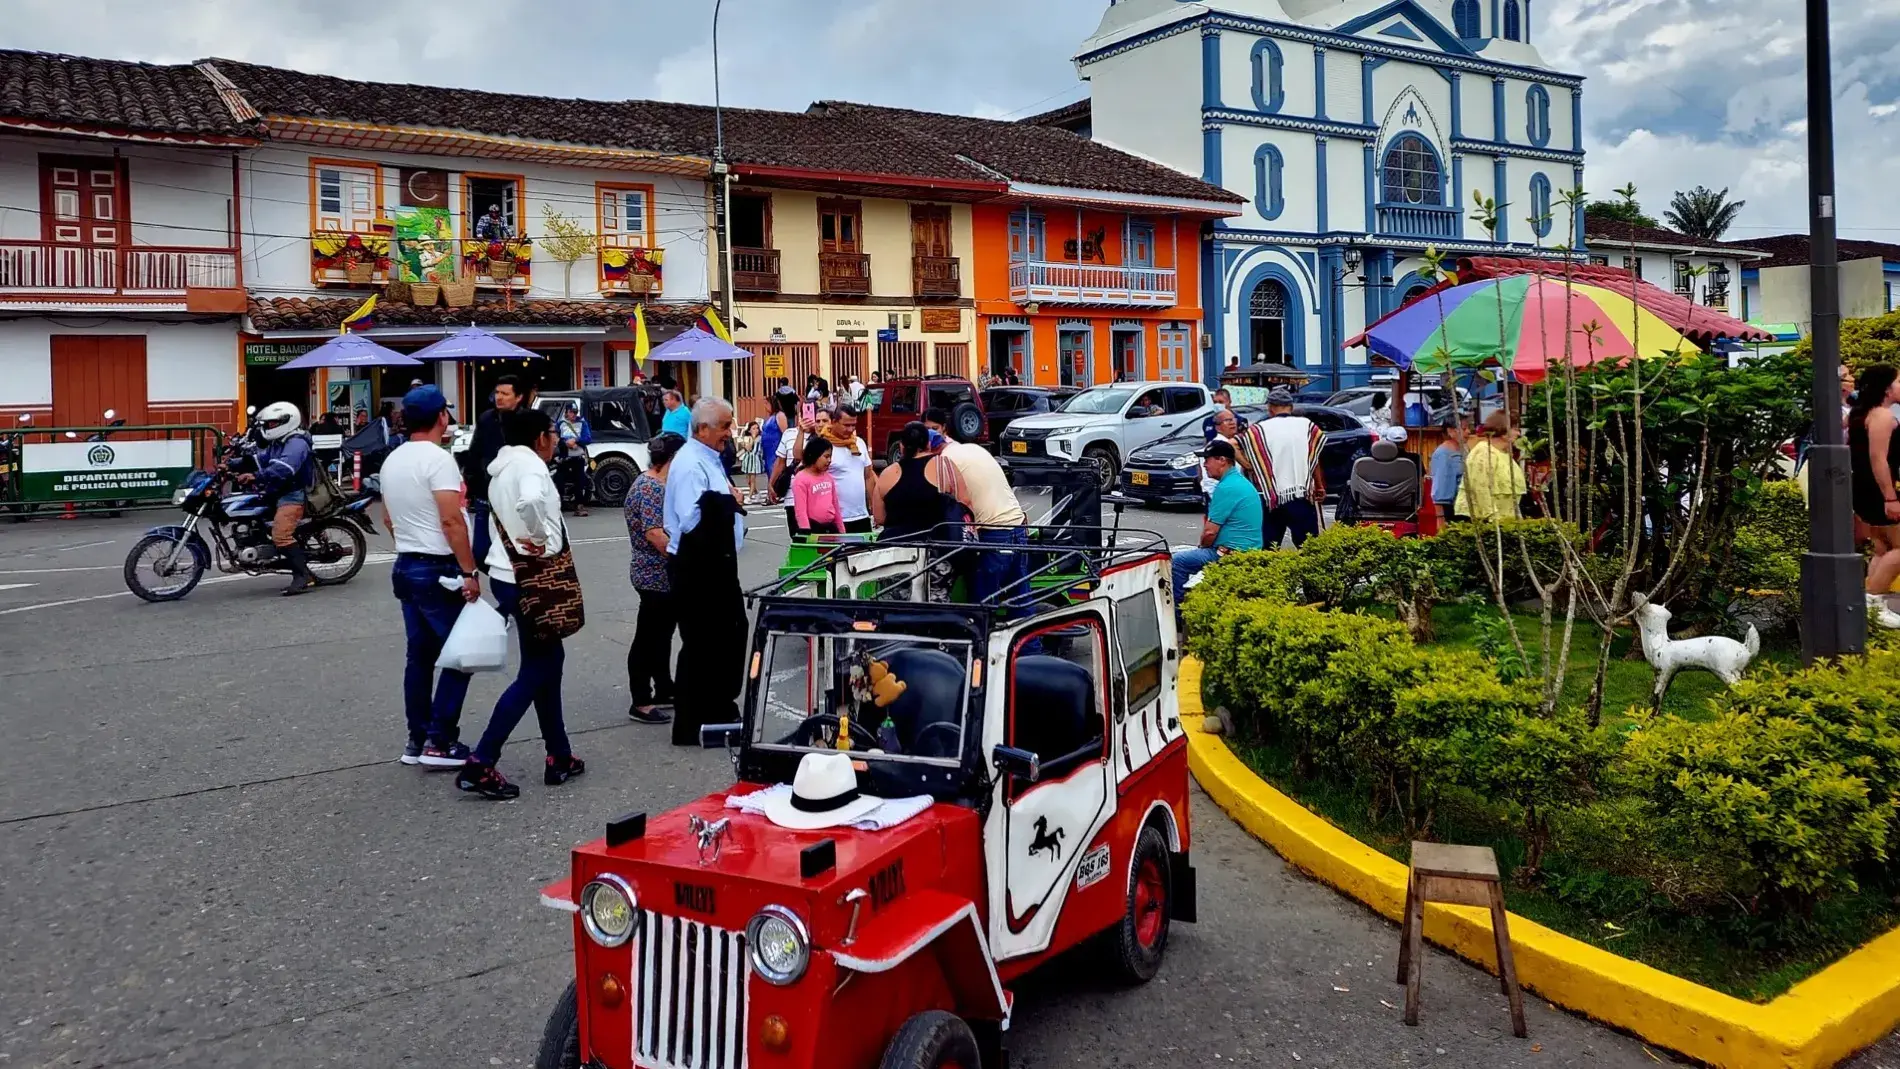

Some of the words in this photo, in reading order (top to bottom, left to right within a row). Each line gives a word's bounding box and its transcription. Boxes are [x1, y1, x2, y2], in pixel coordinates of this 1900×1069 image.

[246, 344, 277, 354] HOTEL
[63, 471, 157, 483] DEPARTAMENTO
[71, 482, 118, 491] POLICÍA
[120, 479, 169, 488] QUINDÍO
